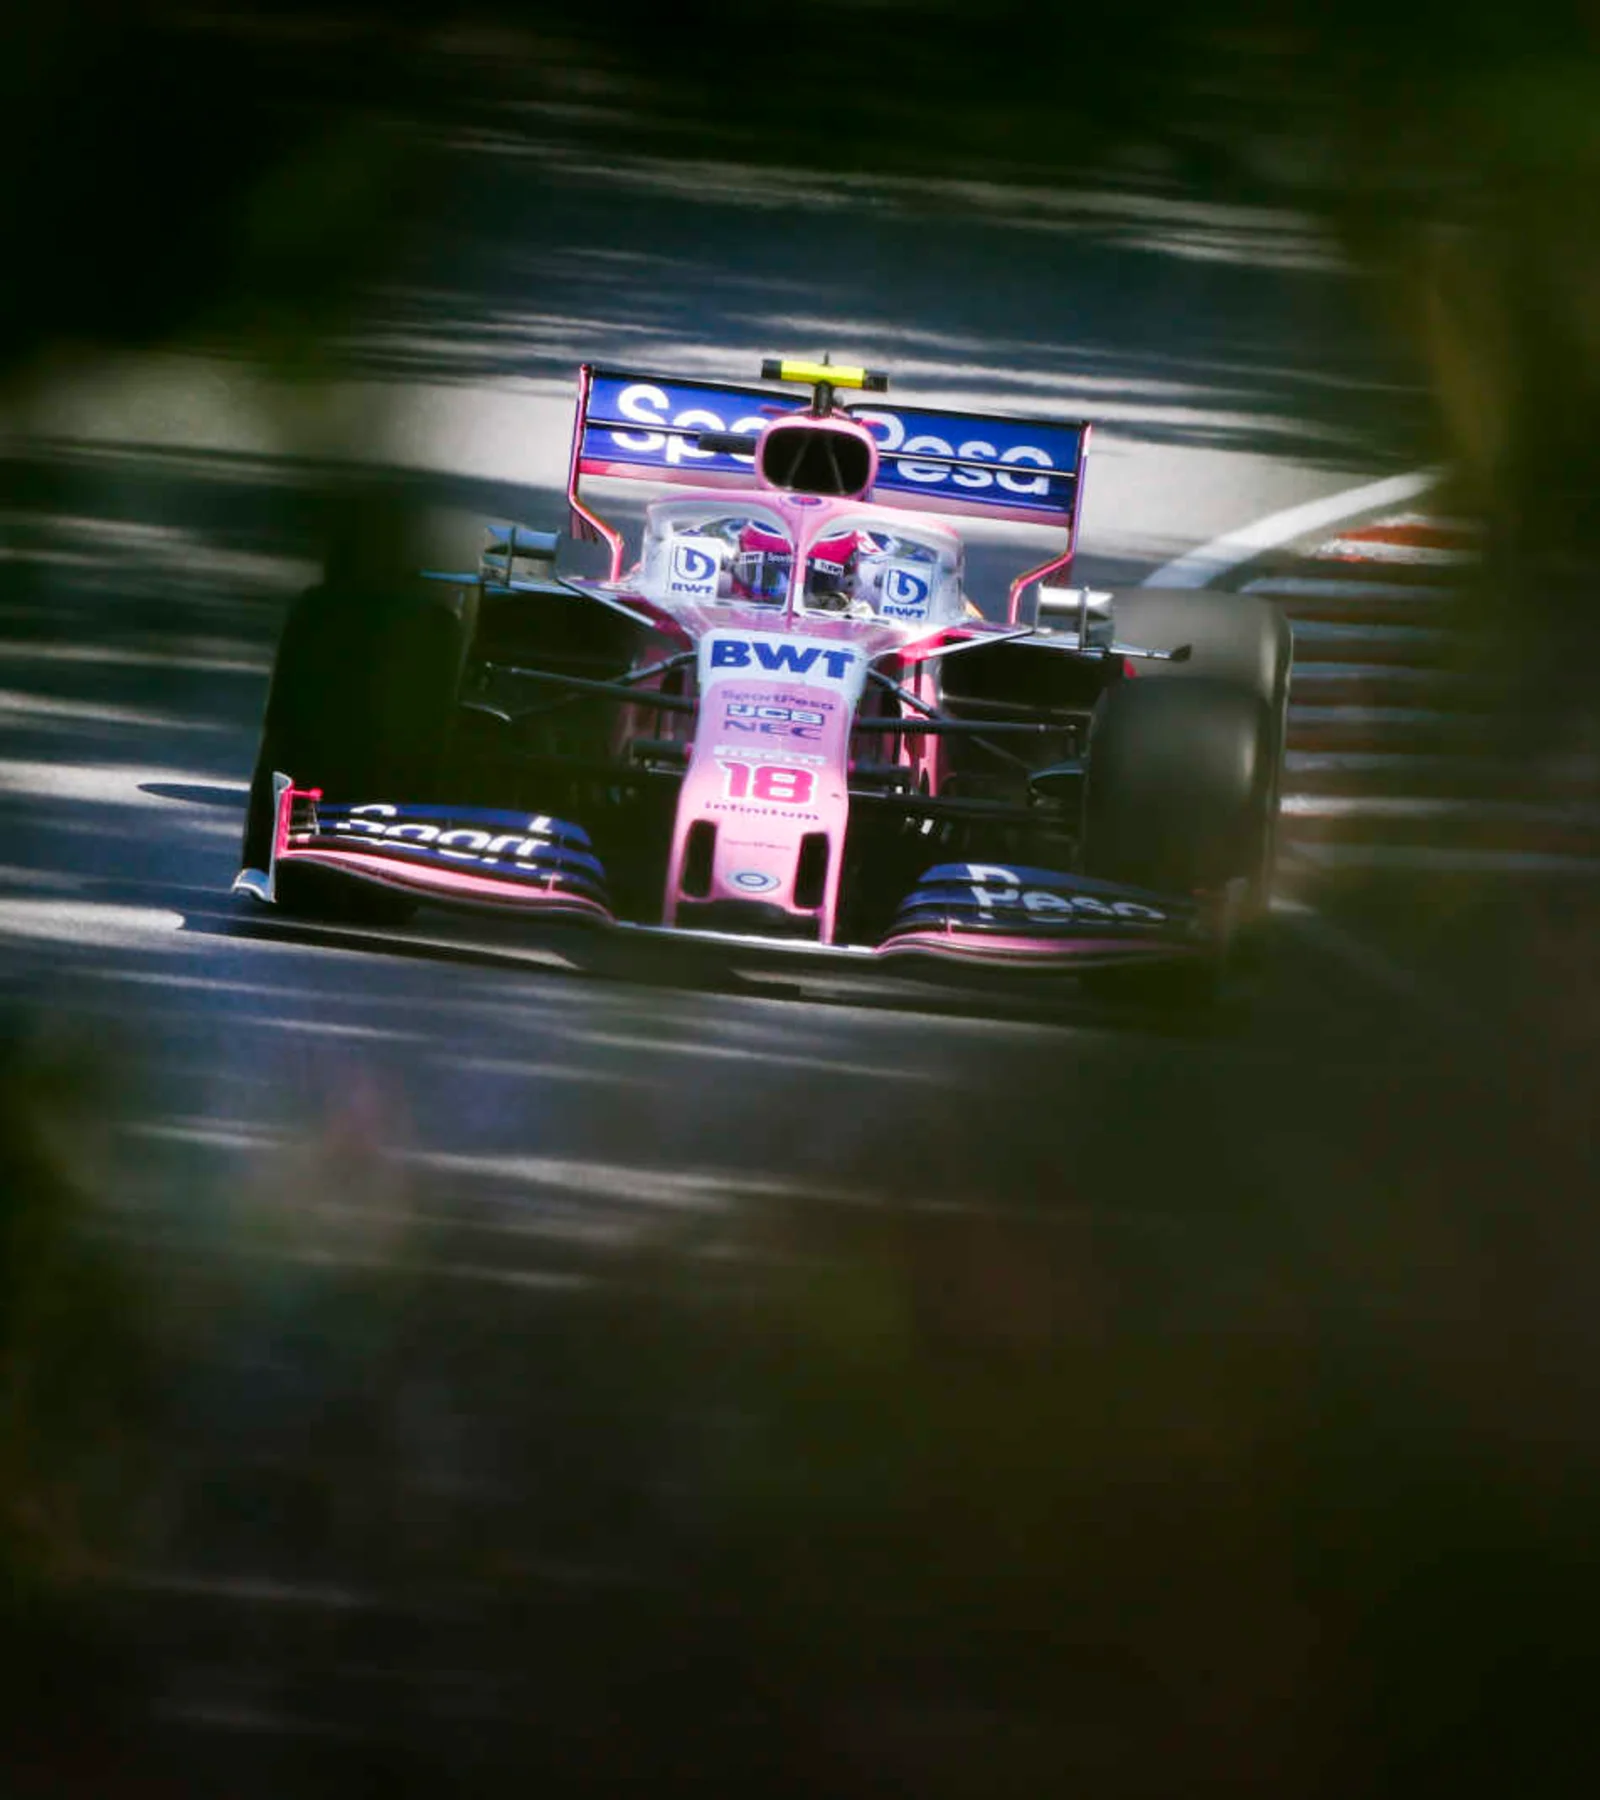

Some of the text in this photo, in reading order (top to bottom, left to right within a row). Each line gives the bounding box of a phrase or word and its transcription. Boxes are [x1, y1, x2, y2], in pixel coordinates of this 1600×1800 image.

[672, 582, 714, 594] BWT
[883, 606, 925, 619] BWT
[711, 640, 854, 679] BWT
[727, 704, 824, 725] JCB
[724, 720, 822, 740] NEC
[722, 761, 814, 804] 18
[335, 804, 563, 881] Sport
[966, 864, 1168, 927] Pesa
